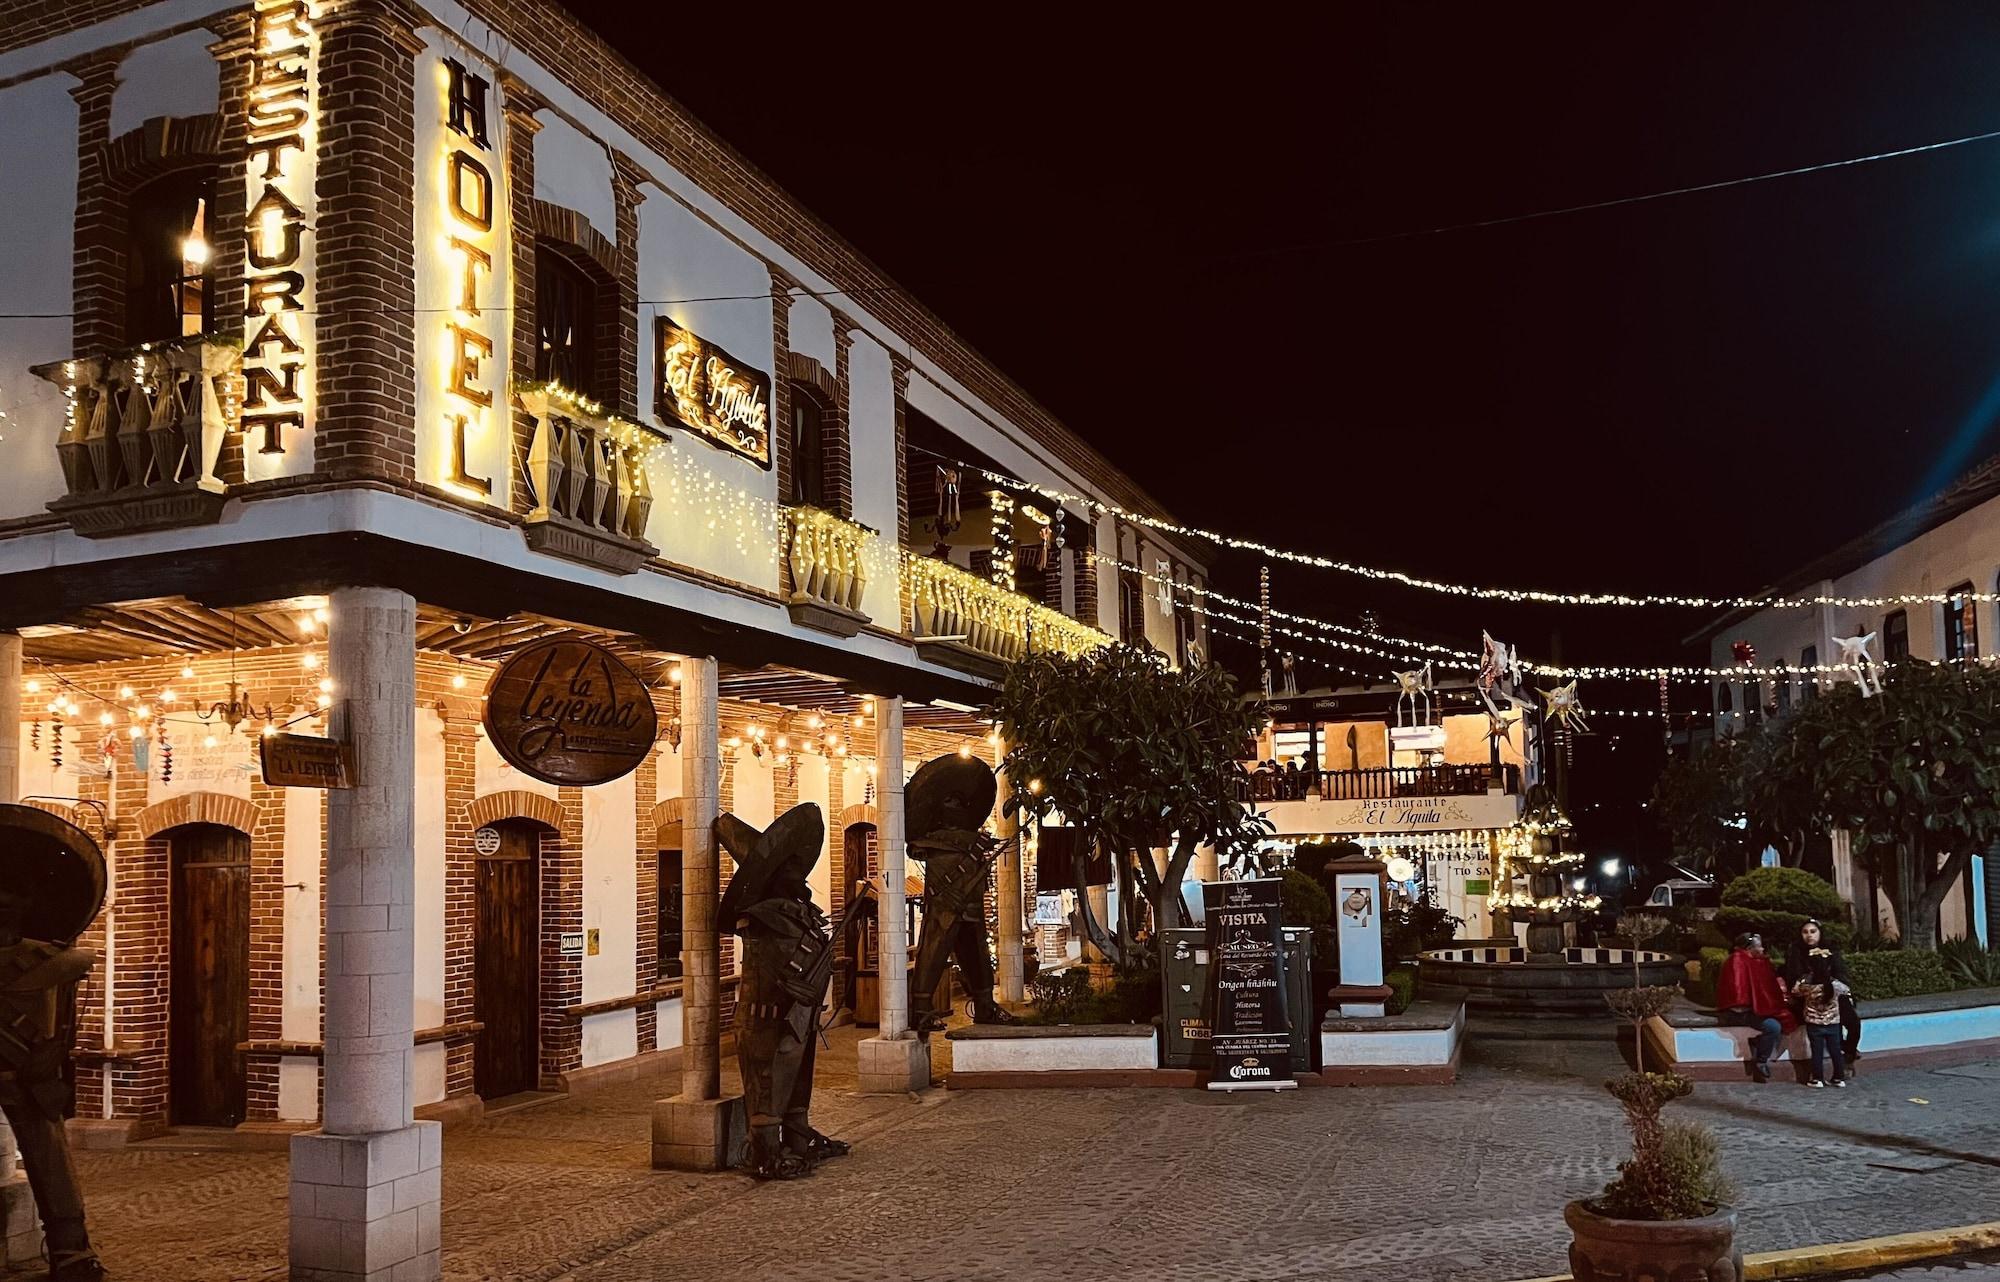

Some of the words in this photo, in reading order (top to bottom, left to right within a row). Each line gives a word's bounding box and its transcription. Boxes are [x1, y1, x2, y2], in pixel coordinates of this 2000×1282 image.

[241, 0, 310, 455] RESTAURANT
[443, 57, 493, 495] HOTEL
[665, 341, 699, 398] El
[518, 648, 642, 759] Leyenda
[280, 758, 294, 774] LA
[1363, 797, 1447, 809] Restaurante
[1366, 809, 1385, 825] El
[1219, 913, 1267, 926] VISITA
[562, 936, 583, 949] SALIDA
[1229, 943, 1260, 951] MUSEO
[1218, 980, 1245, 992] Origen
[1235, 991, 1259, 999] Cultura
[1180, 1018, 1204, 1027] CLIMA
[1230, 1065, 1270, 1079] Corona
